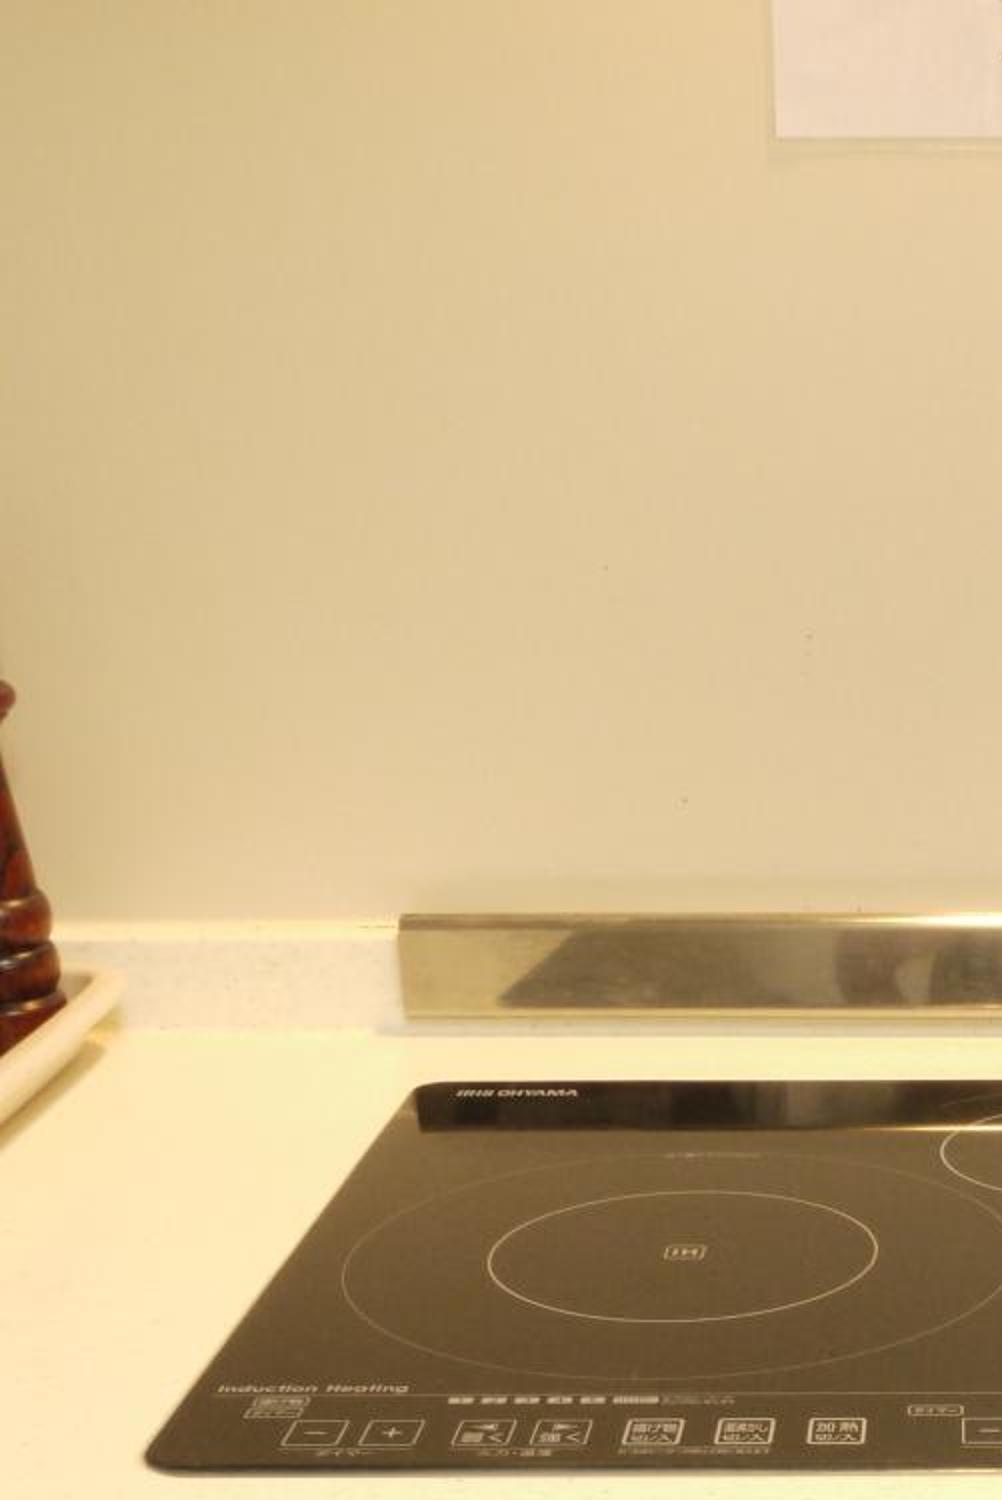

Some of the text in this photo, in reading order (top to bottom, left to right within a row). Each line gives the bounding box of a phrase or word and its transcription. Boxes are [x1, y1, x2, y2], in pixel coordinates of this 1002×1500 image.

[497, 1088, 578, 1097] OHYAMA
[217, 1383, 410, 1395] Induction Heating
[814, 1421, 859, 1432] 加熱
